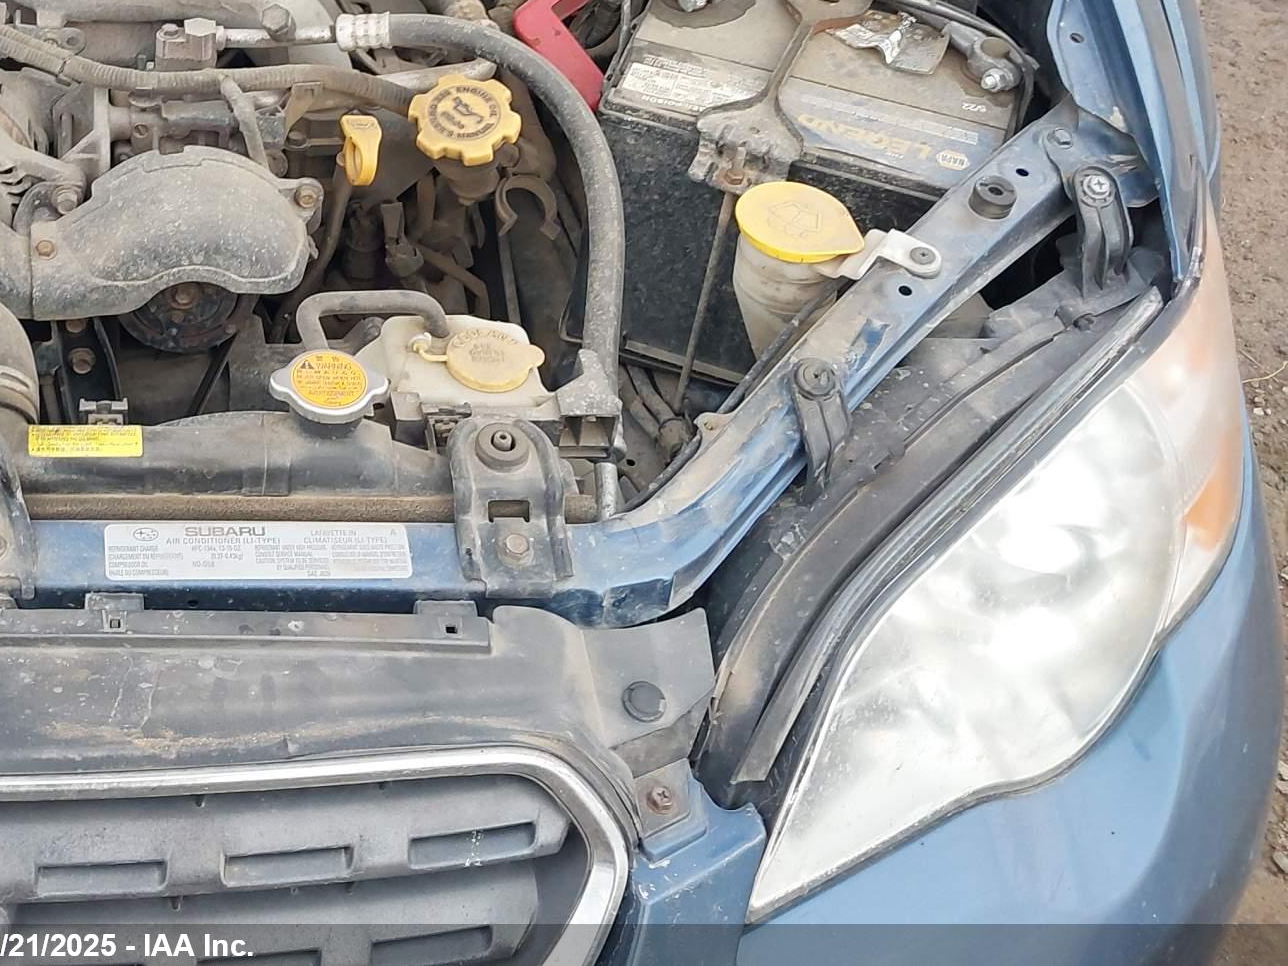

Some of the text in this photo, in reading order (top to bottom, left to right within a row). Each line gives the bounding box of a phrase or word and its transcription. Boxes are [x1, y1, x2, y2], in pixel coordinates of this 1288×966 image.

[185, 526, 265, 537] SUBARU
[166, 537, 181, 545] AIR
[182, 537, 241, 545] CONDITIONER
